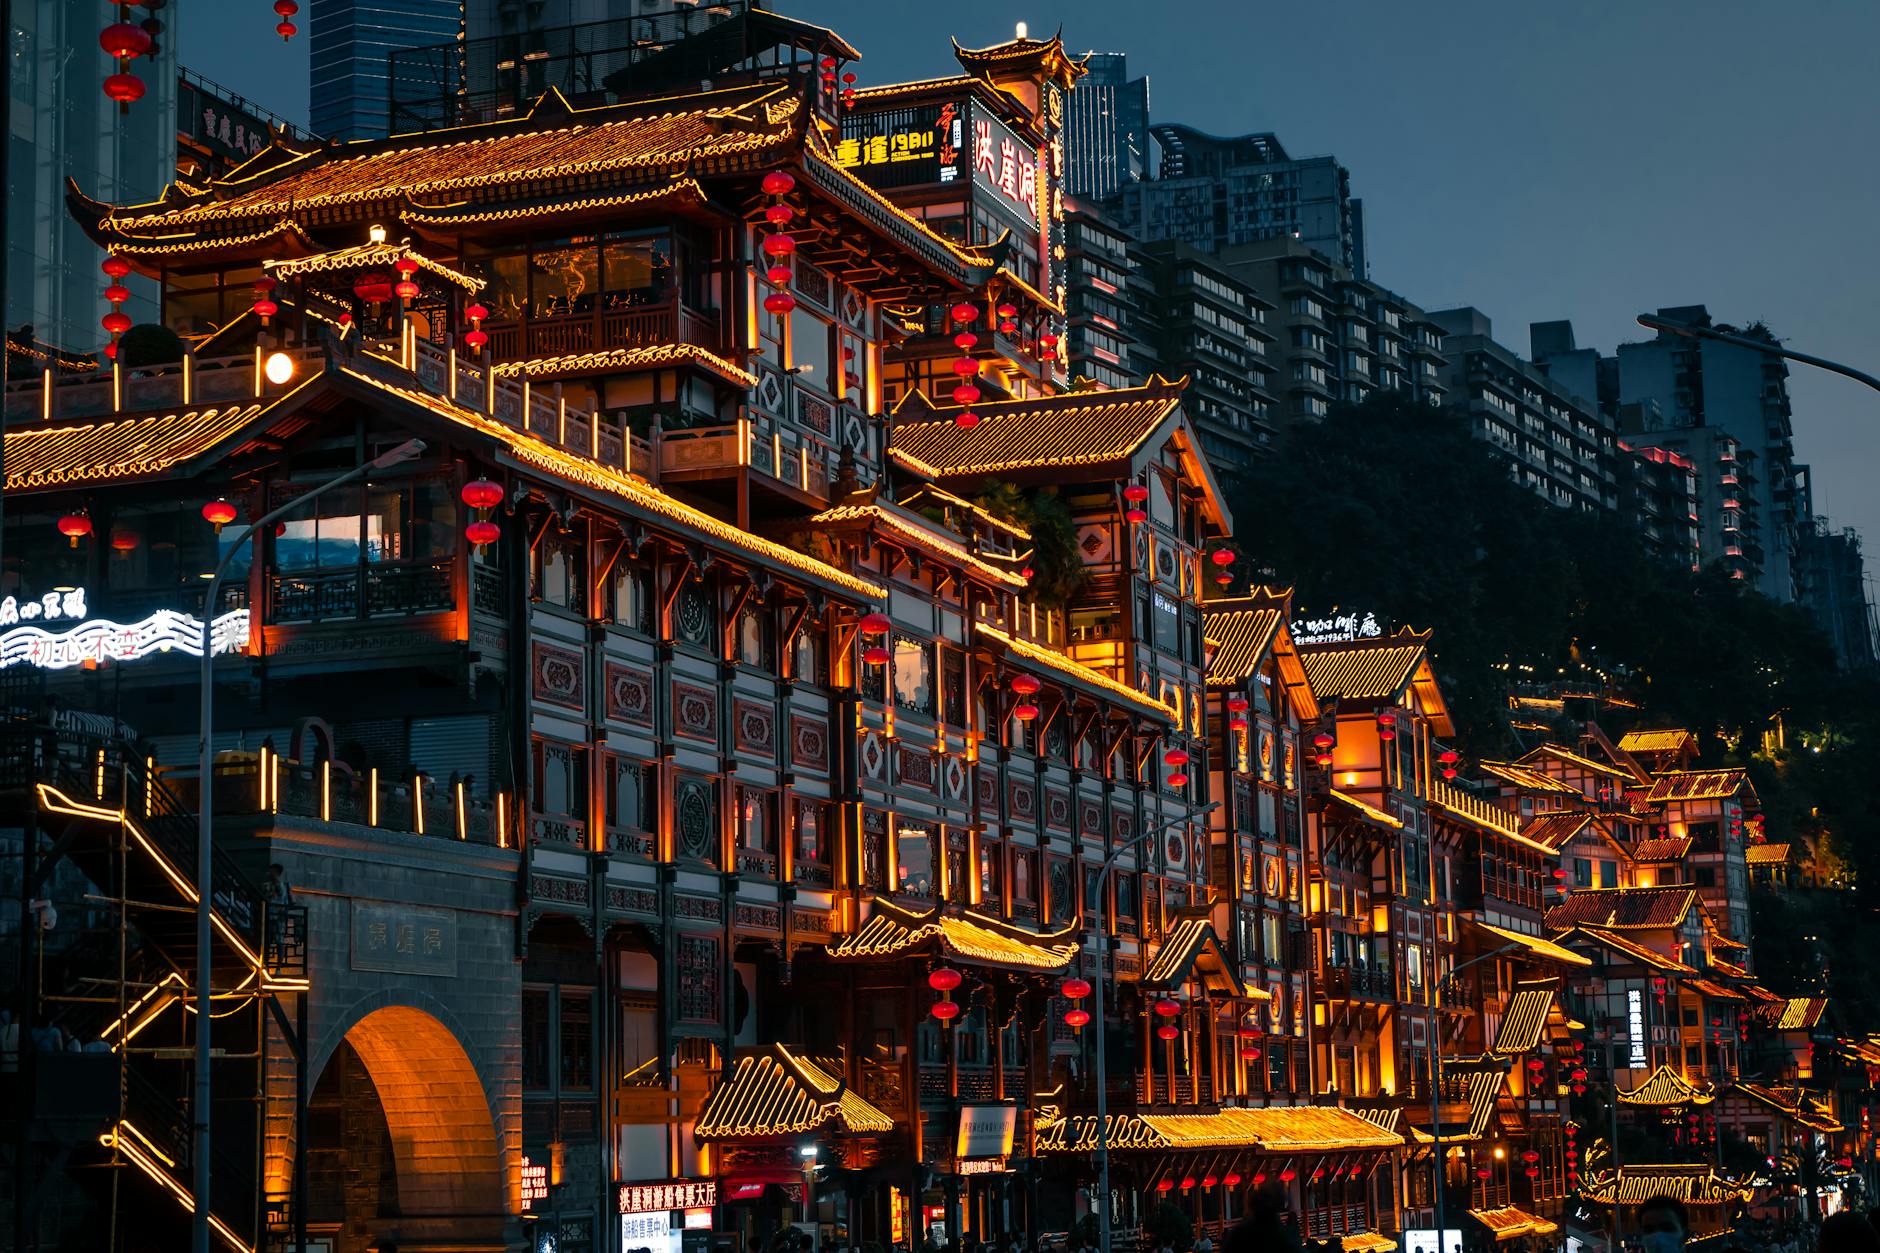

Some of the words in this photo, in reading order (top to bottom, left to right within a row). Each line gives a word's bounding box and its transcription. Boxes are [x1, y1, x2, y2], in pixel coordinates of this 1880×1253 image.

[975, 120, 1037, 217] 洪崖洞
[30, 630, 141, 664] 初心不变
[620, 1184, 716, 1211] 洪崖洞游船售票大厅
[624, 1217, 669, 1240] 游船售票中心
